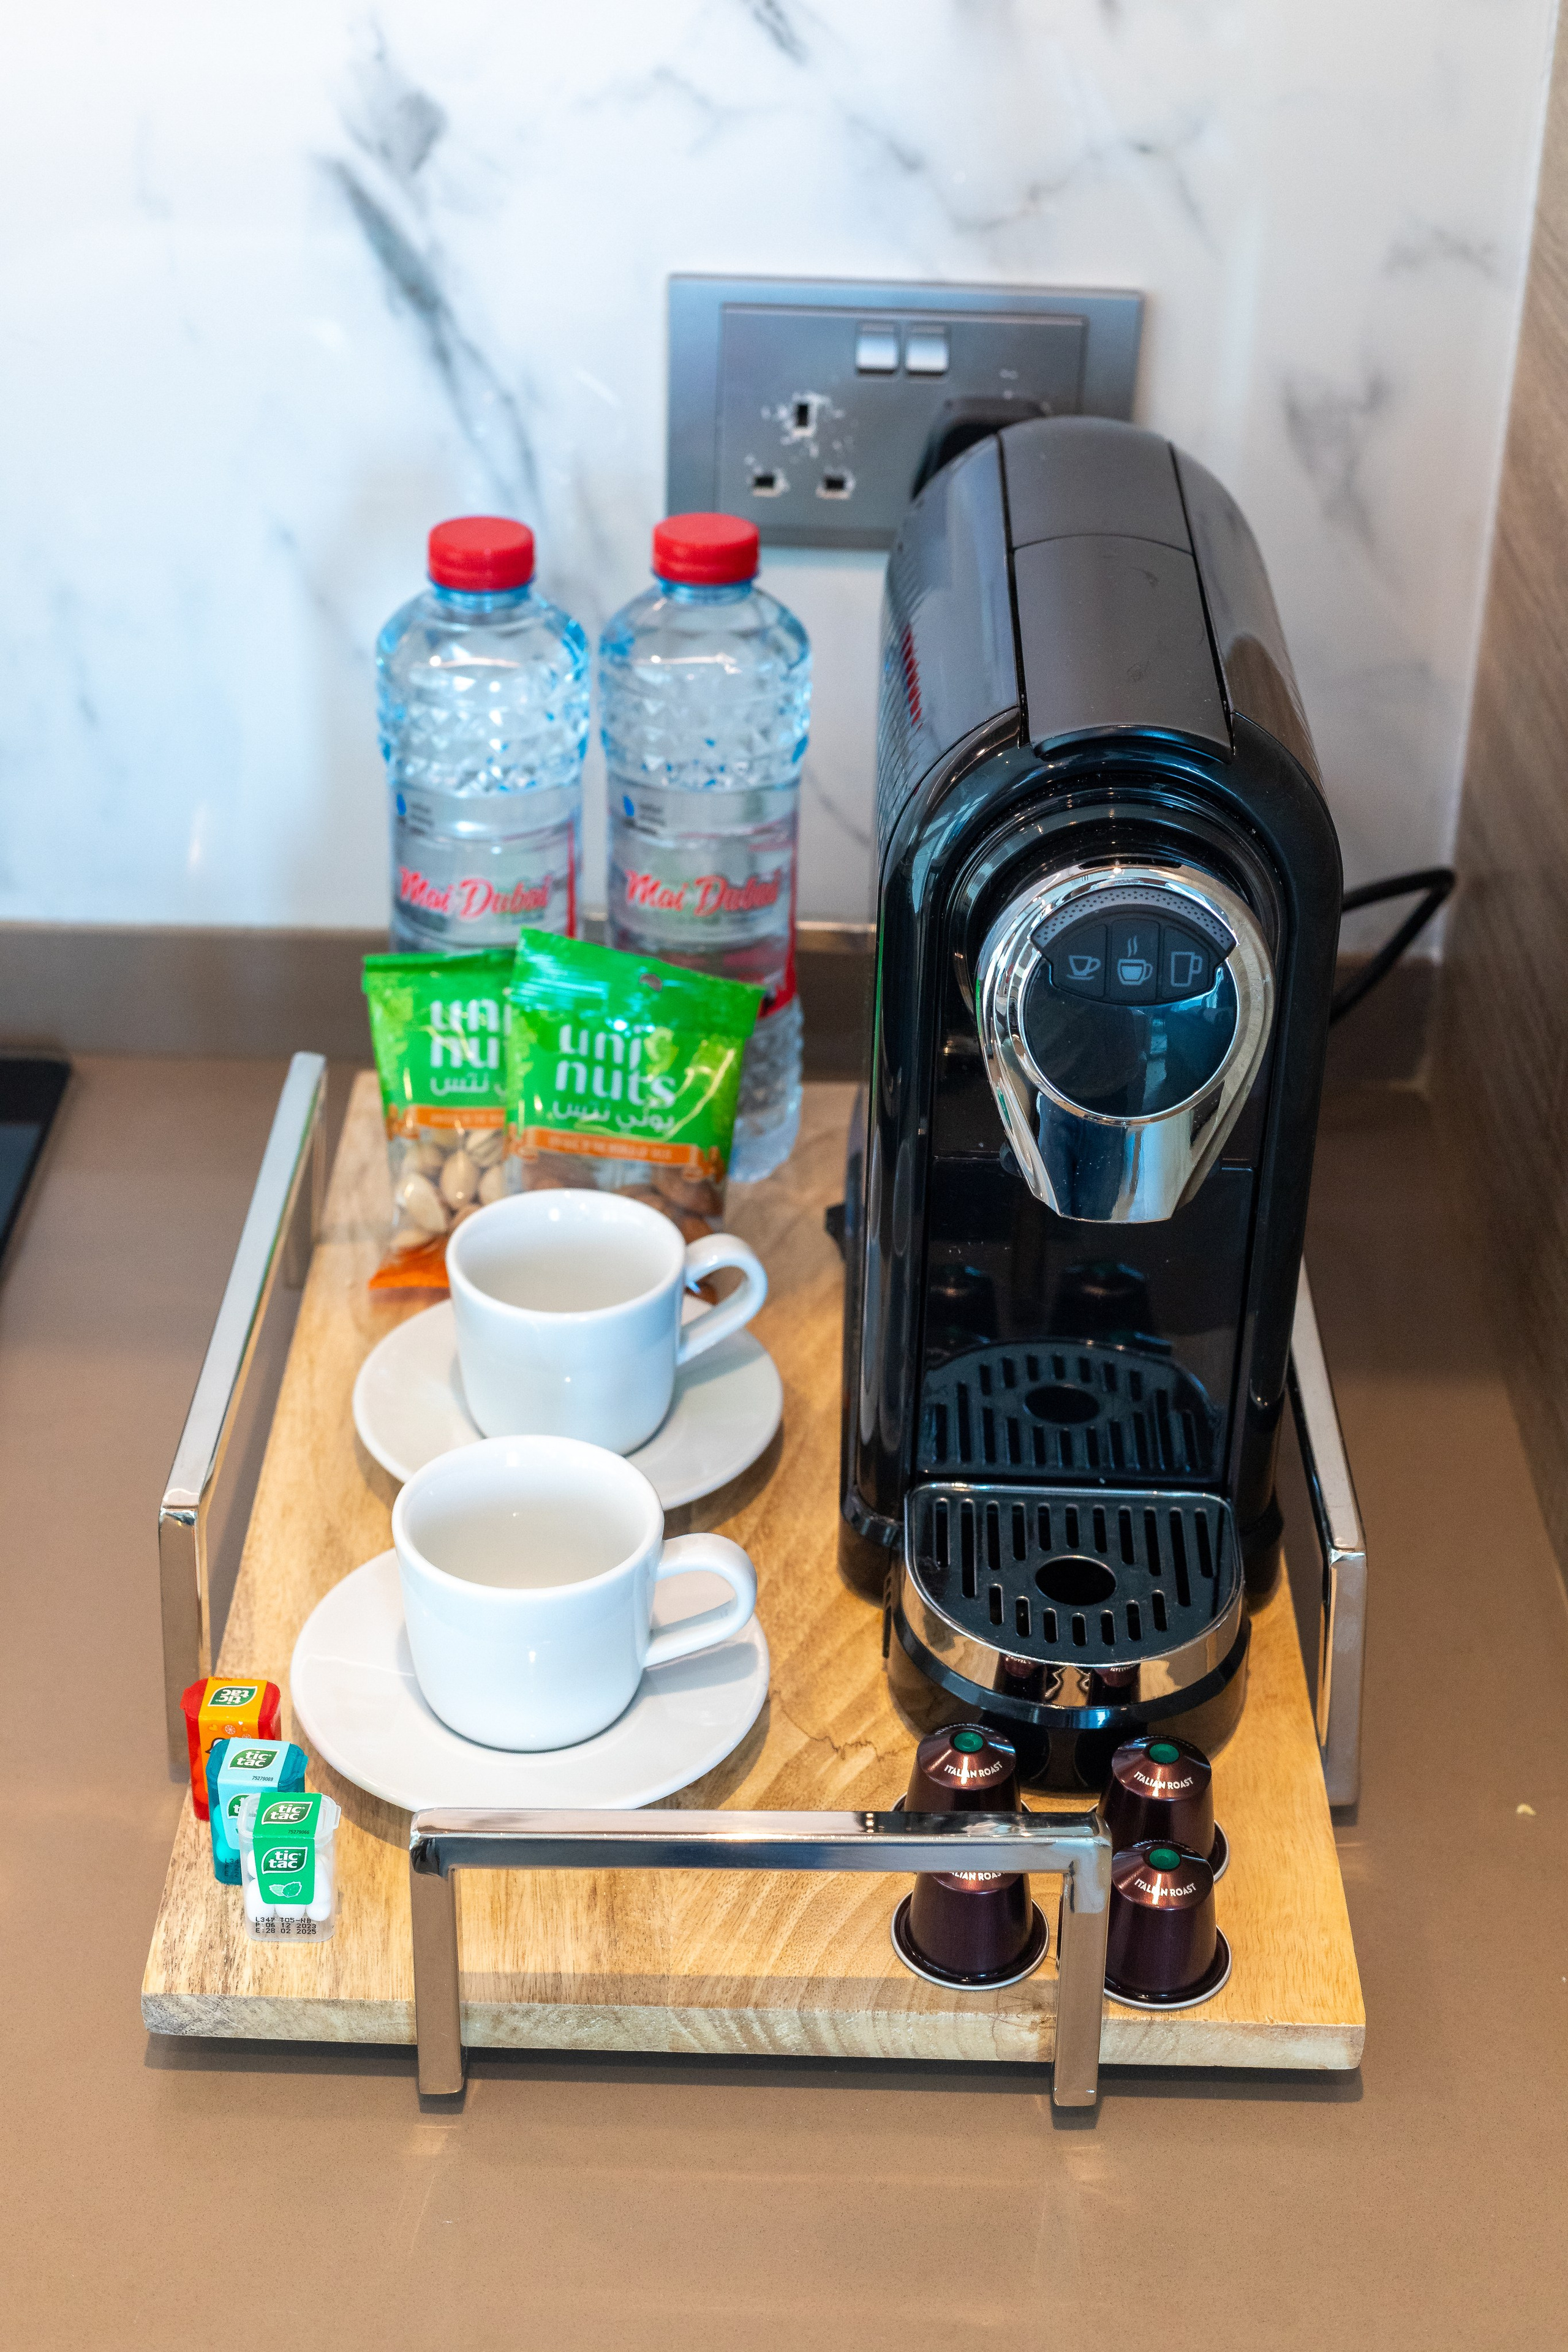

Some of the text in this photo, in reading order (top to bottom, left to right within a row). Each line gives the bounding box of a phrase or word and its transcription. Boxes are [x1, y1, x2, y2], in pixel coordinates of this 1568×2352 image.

[399, 867, 454, 911] Mai
[624, 870, 688, 911] Mai
[558, 1024, 644, 1071] uni
[555, 1060, 676, 1107] nuts
[221, 1689, 249, 1698] tac
[245, 1751, 270, 1760] tic
[237, 1757, 266, 1767] tac
[978, 1761, 1003, 1777] ROAST
[1133, 1771, 1194, 1789] ITALIAN ROAST
[278, 1804, 302, 1814] tic
[270, 1811, 300, 1820] tac
[274, 1850, 298, 1861] tic
[268, 1858, 298, 1869] tac
[1169, 1883, 1196, 1897] ROAST
